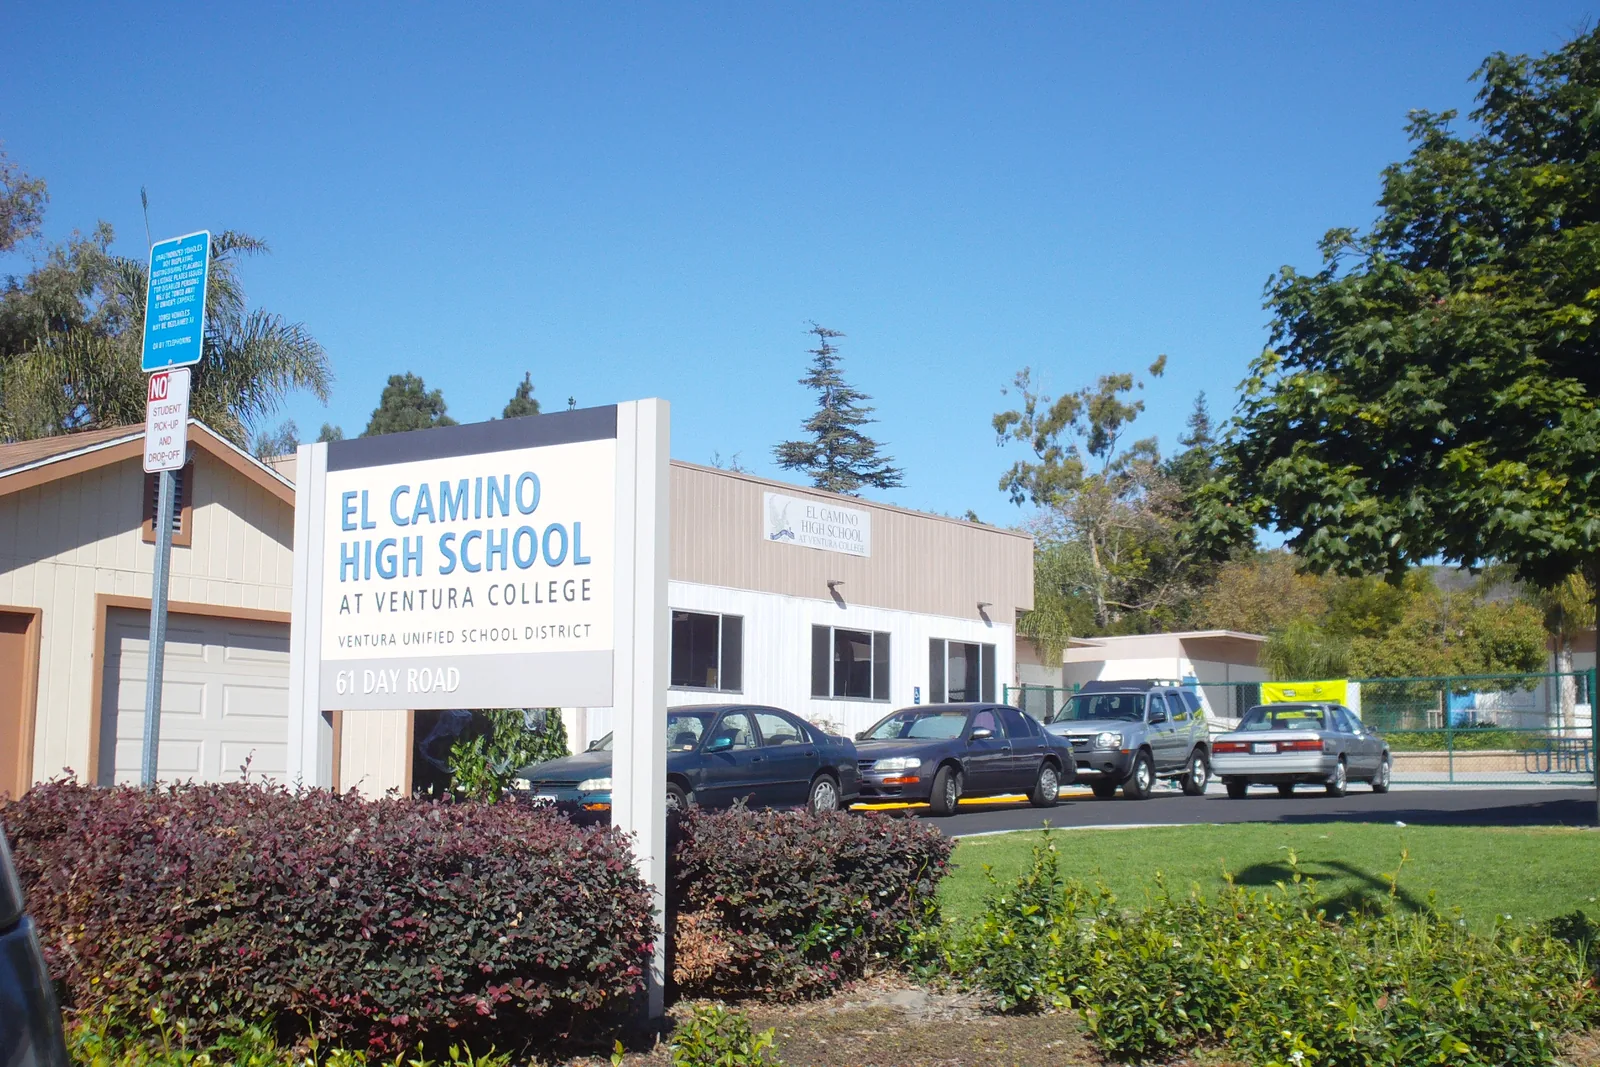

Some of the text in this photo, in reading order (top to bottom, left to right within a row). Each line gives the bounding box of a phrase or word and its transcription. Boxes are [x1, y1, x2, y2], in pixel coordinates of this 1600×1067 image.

[150, 376, 168, 399] NO
[153, 404, 181, 416] STUDENT
[153, 419, 179, 432] PICK-UP
[159, 436, 172, 446] AND
[149, 450, 180, 463] DROP-OFF
[341, 471, 541, 532] EL CAMINO
[806, 505, 859, 526] EL CAMINO
[801, 520, 863, 542] HIGH SCHOOL
[340, 522, 591, 582] HIGH SCHOOL
[799, 534, 865, 553] AT VENTURA COLLEGE
[339, 579, 591, 615] AT VENTURA COLLEGE
[338, 624, 591, 648] VENTURA UNIFIED SCHOOL DISTRICT
[335, 667, 460, 695] 61 DAY ROAD
